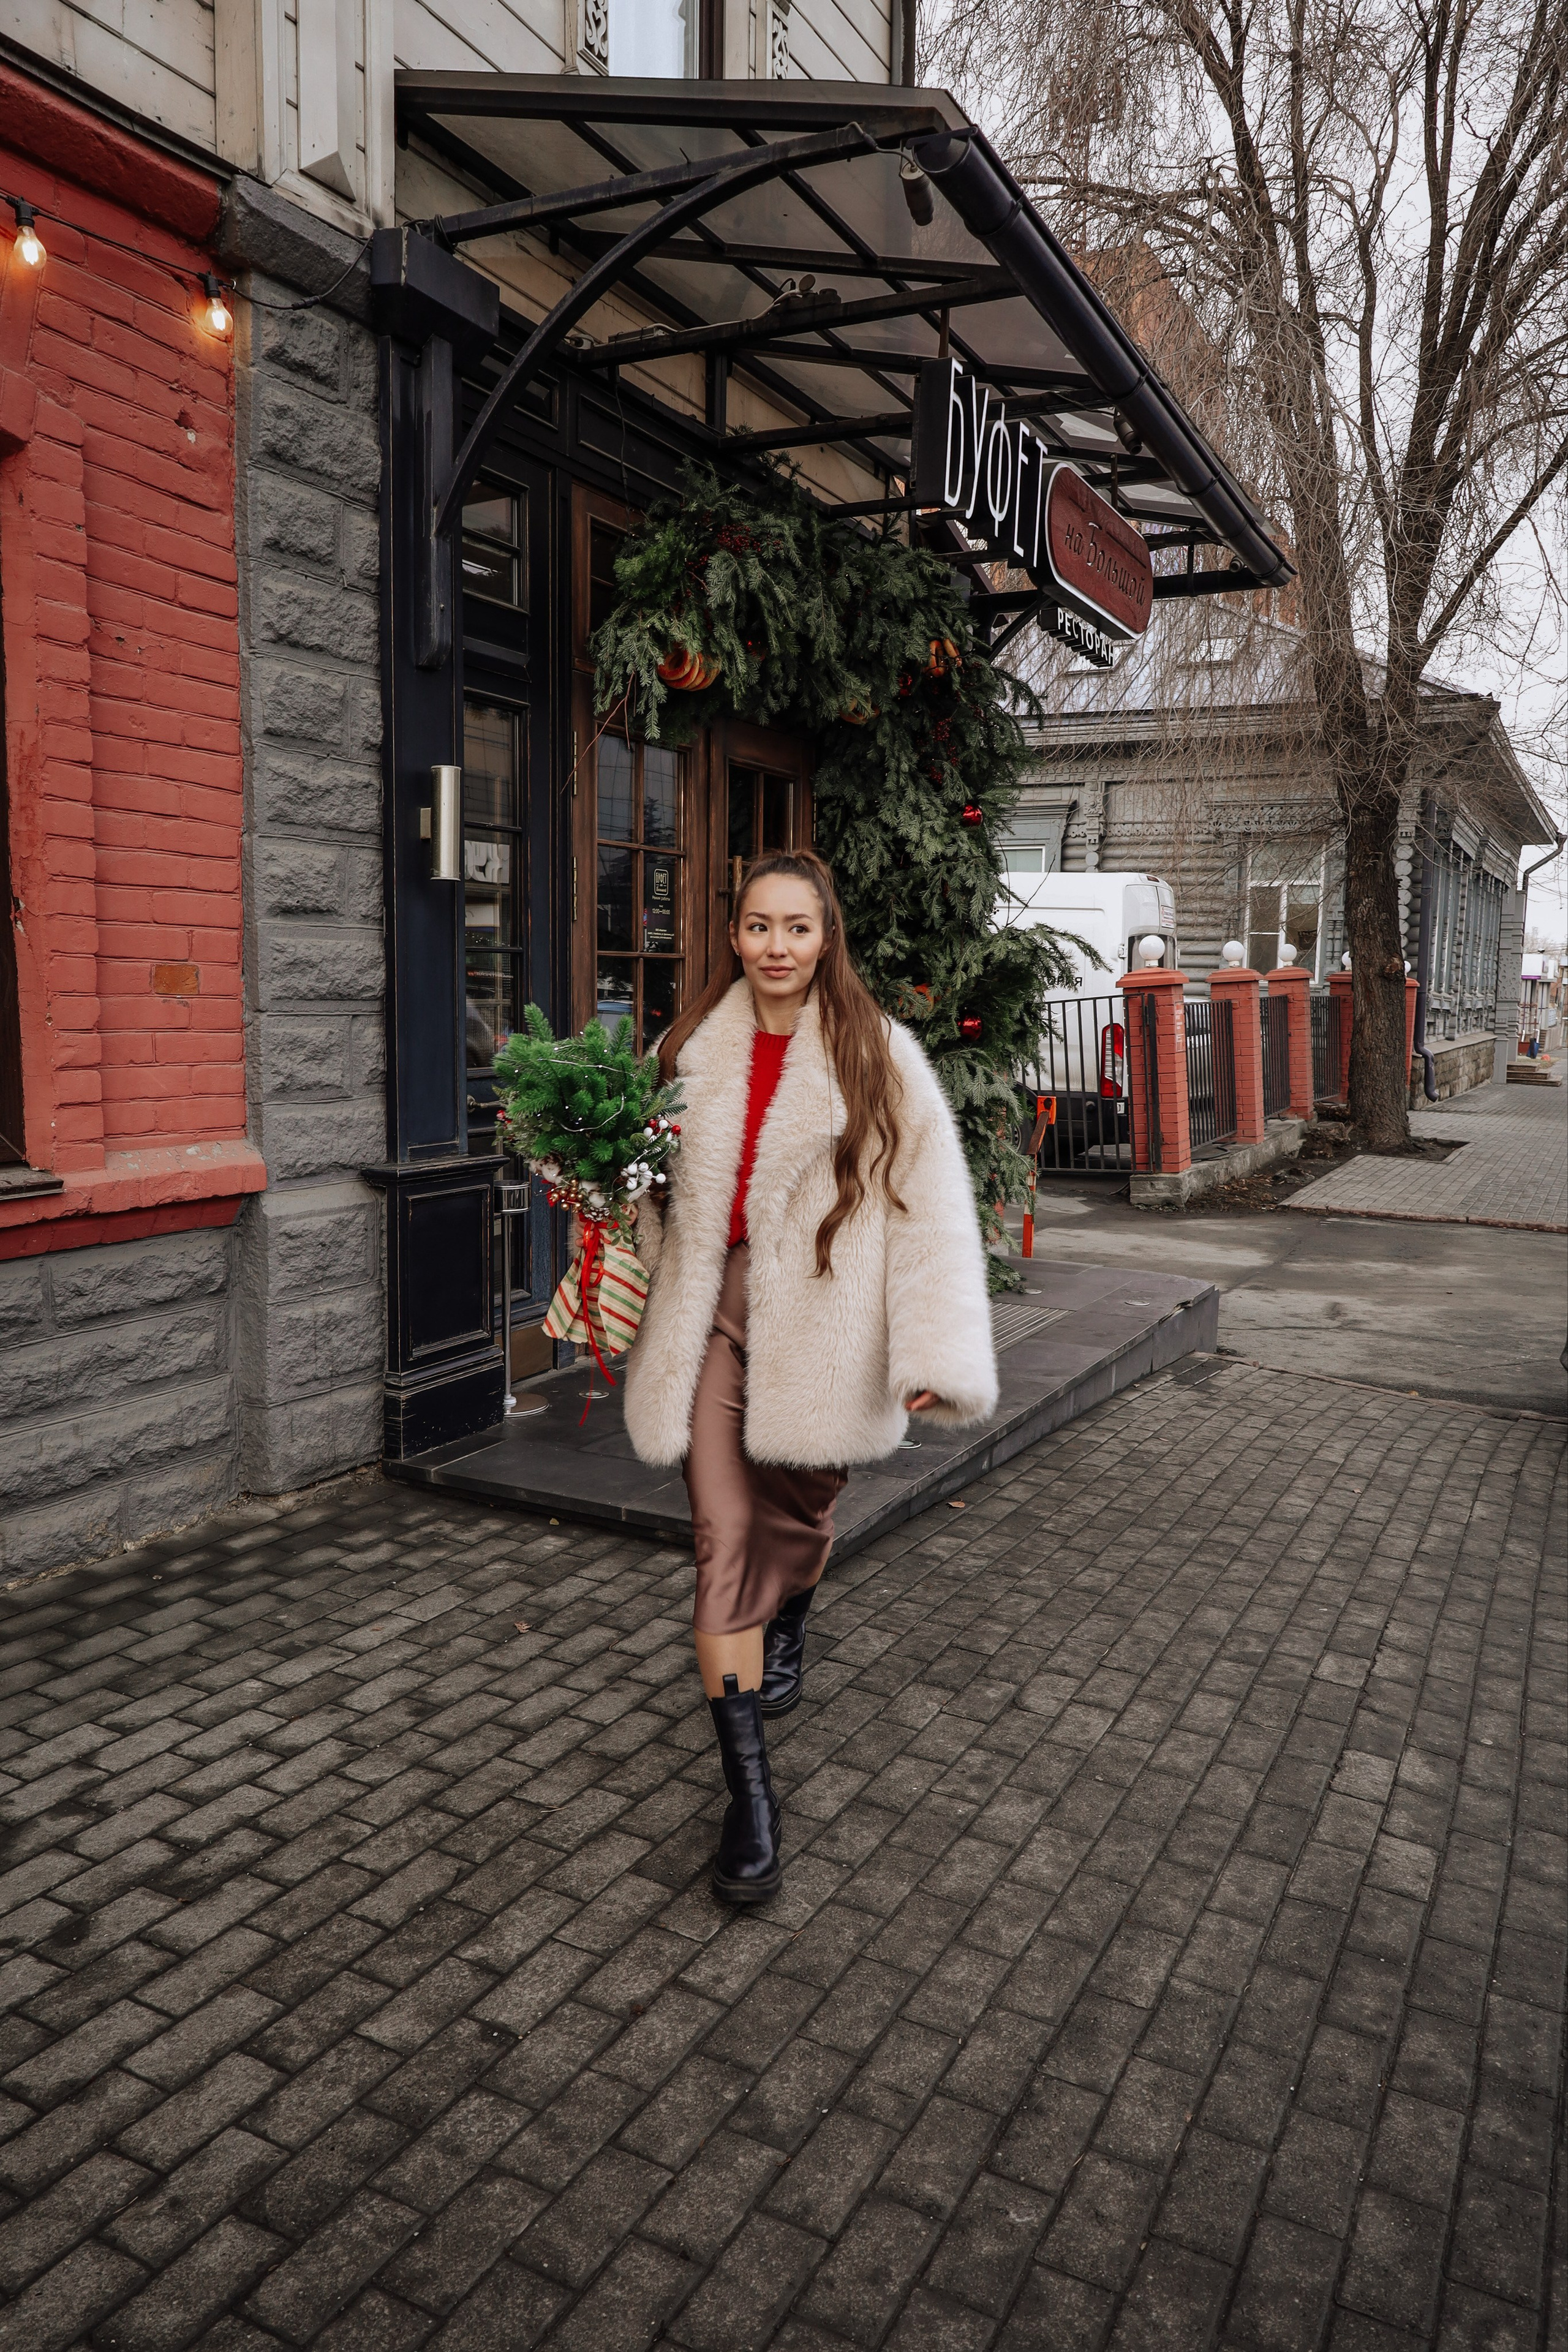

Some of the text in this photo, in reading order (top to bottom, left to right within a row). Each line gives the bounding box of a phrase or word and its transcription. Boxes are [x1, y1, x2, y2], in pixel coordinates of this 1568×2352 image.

[944, 357, 1048, 567] БУФЕТ
[1065, 522, 1145, 606] на Большой
[1057, 607, 1114, 666] РЕСТОРАН
